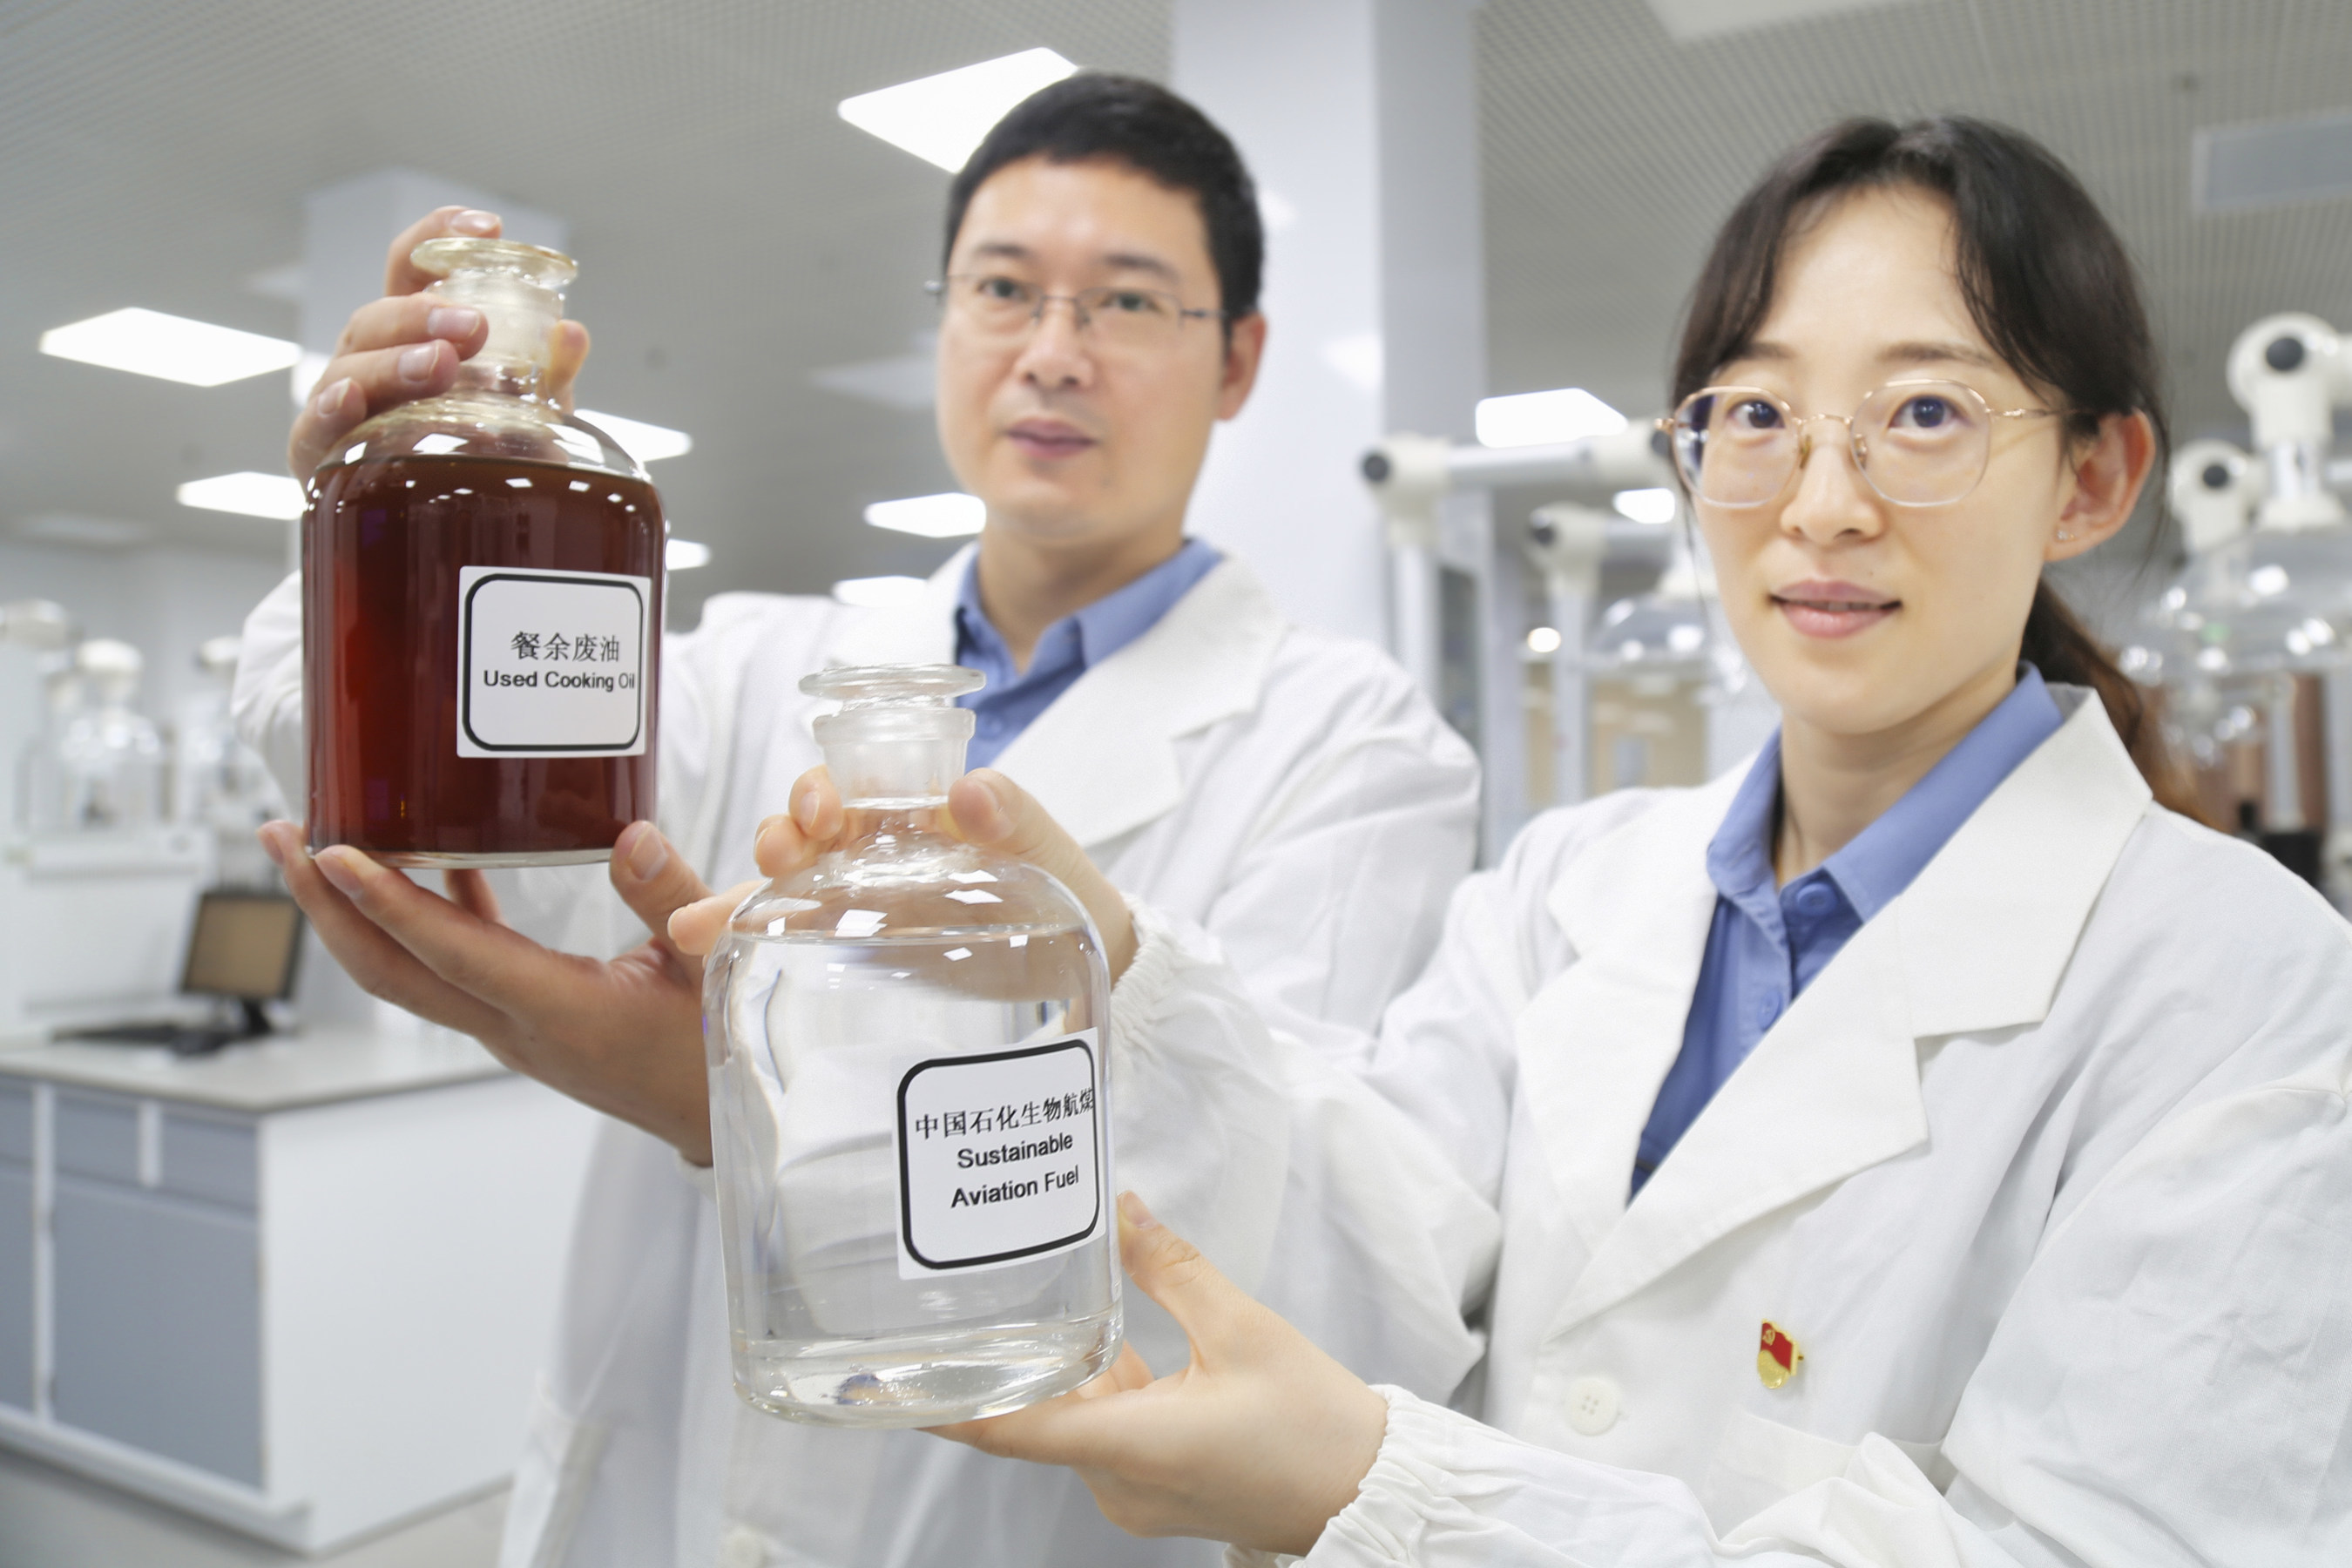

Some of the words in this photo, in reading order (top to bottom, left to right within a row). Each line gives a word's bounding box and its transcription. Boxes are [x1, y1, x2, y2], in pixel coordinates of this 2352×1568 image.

[510, 631, 619, 662] 餐余废油
[483, 670, 537, 687] Used
[544, 671, 614, 692] Cooking
[618, 672, 635, 689] Oil
[916, 1087, 1095, 1140] 中国石化生物航煤
[957, 1132, 1073, 1169] Sustainable
[950, 1179, 1038, 1208] Aviation
[1044, 1165, 1079, 1193] Fuel
